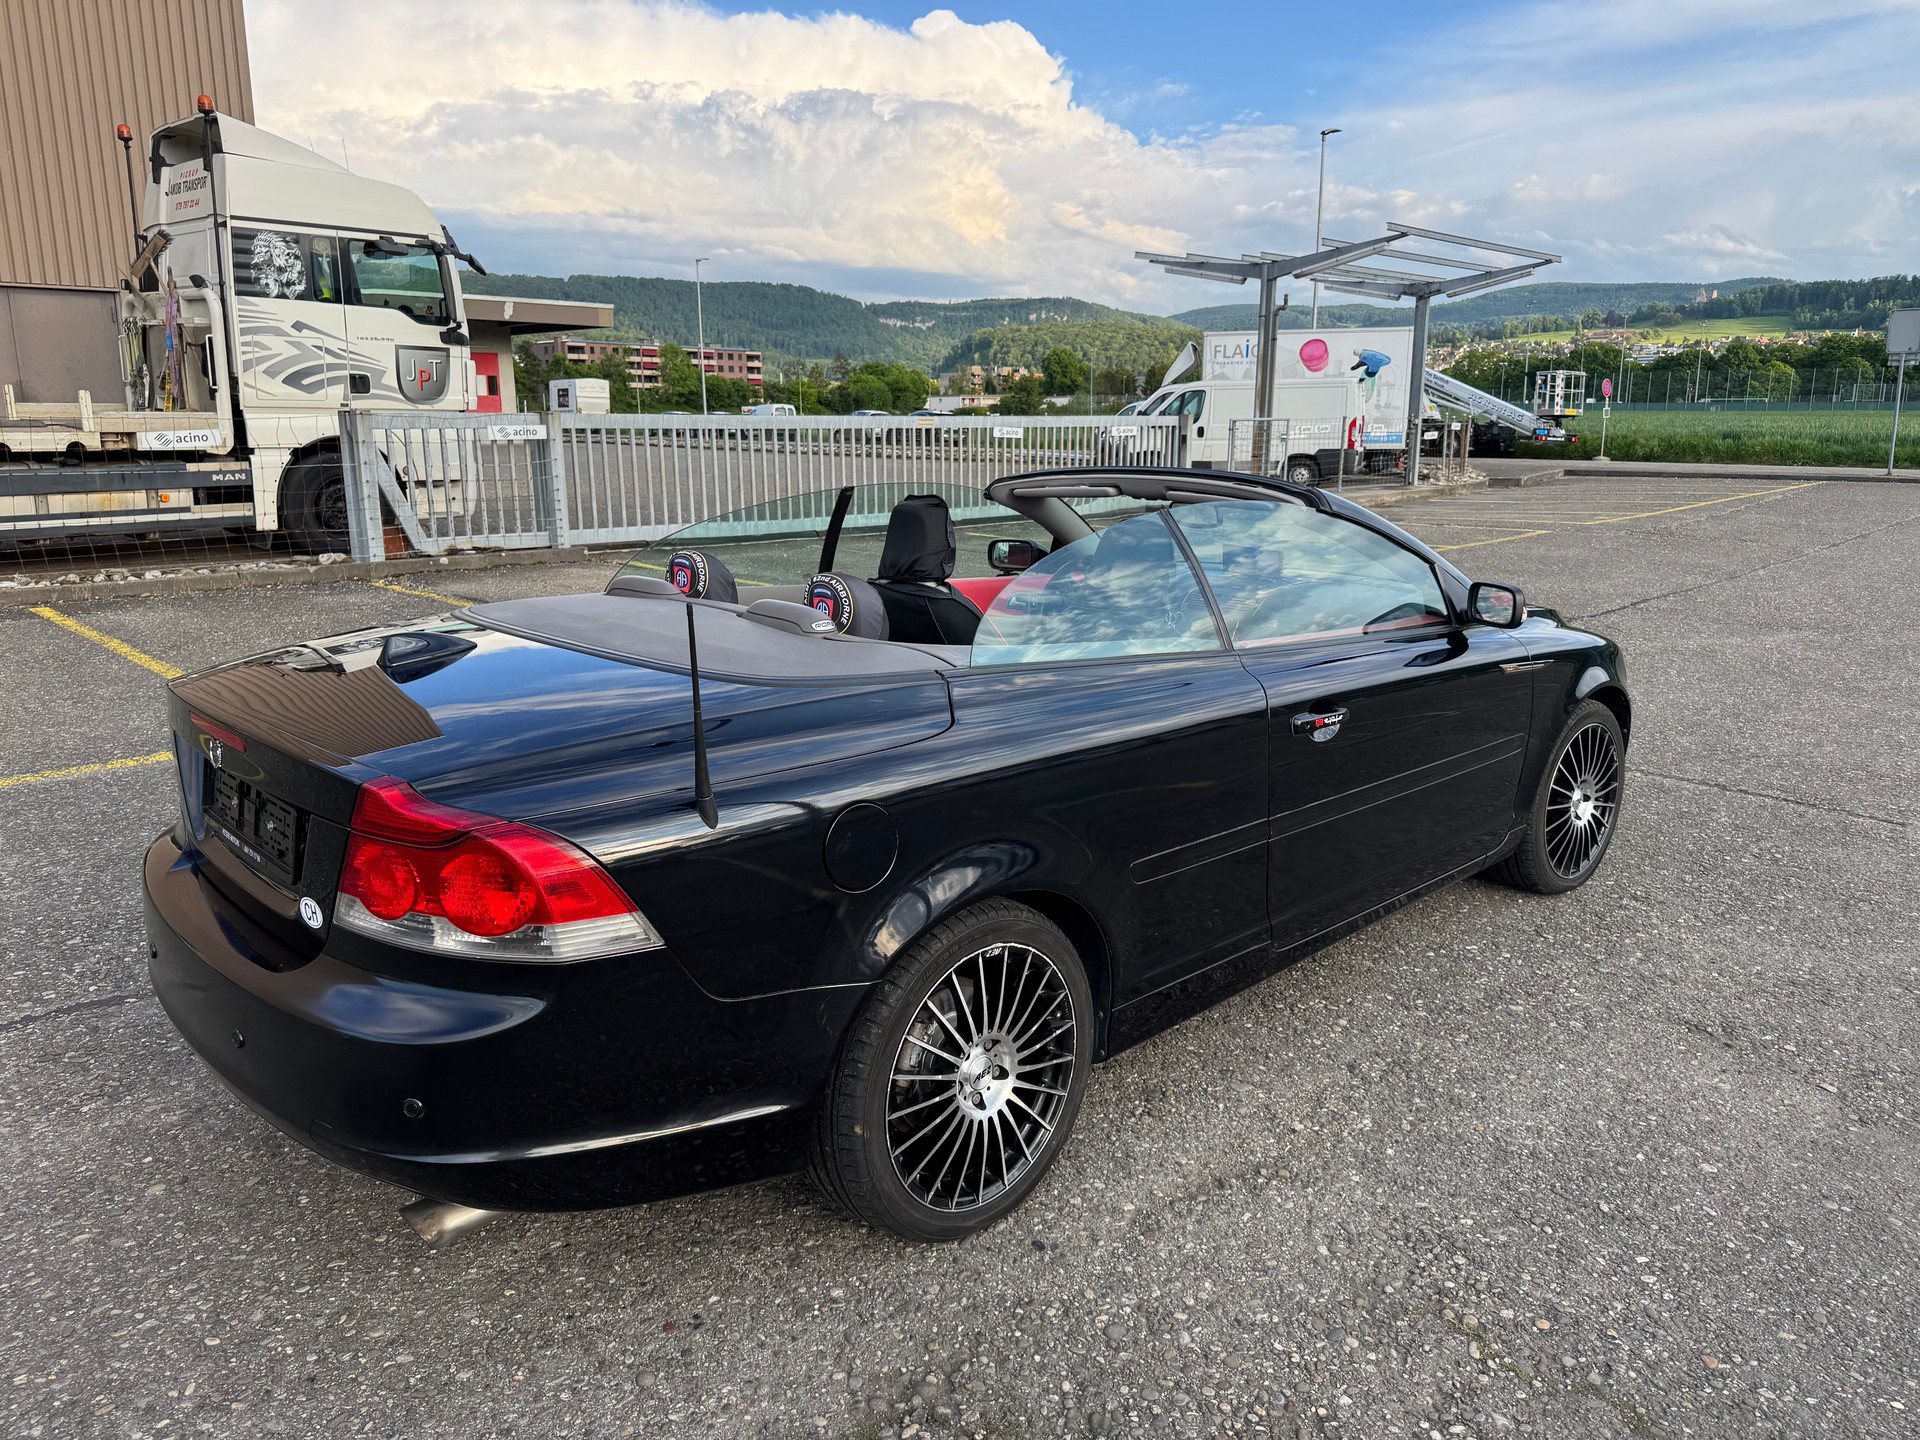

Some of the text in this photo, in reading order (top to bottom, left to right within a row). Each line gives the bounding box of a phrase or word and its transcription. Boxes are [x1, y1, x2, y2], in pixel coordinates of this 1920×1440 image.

[183, 176, 209, 193] TRANSPOR
[176, 432, 209, 444] acino
[513, 427, 537, 436] acino
[212, 473, 246, 481] MAN
[829, 579, 851, 625] AIRBORNE
[304, 902, 319, 923] CH
[972, 1064, 991, 1084] AEZ
